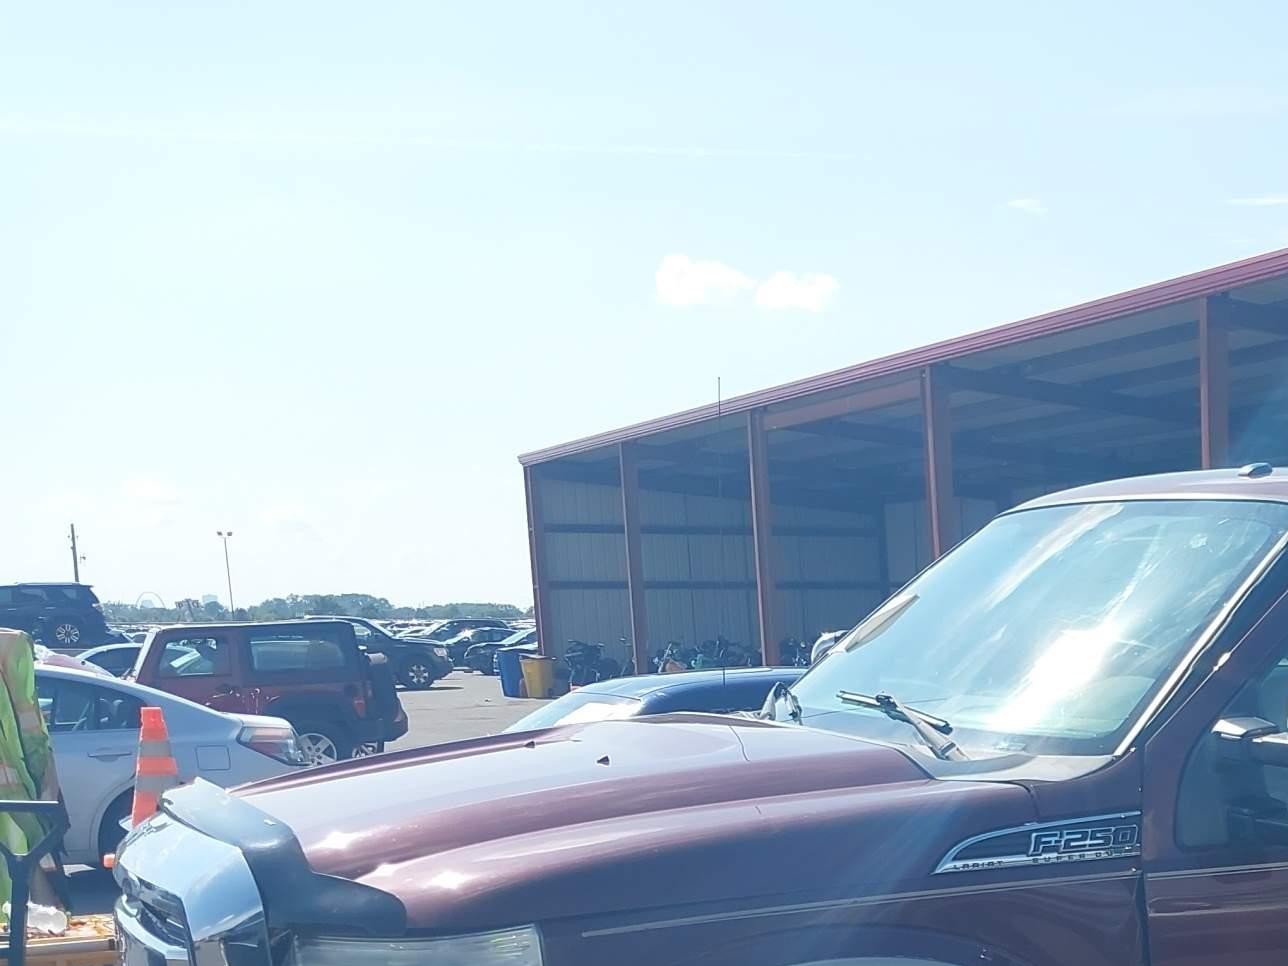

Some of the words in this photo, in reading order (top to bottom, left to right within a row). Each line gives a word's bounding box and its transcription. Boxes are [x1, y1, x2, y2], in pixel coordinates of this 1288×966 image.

[1028, 824, 1139, 857] F-250
[1032, 853, 1086, 864] SUPER
[953, 859, 1004, 870] LARIAT
